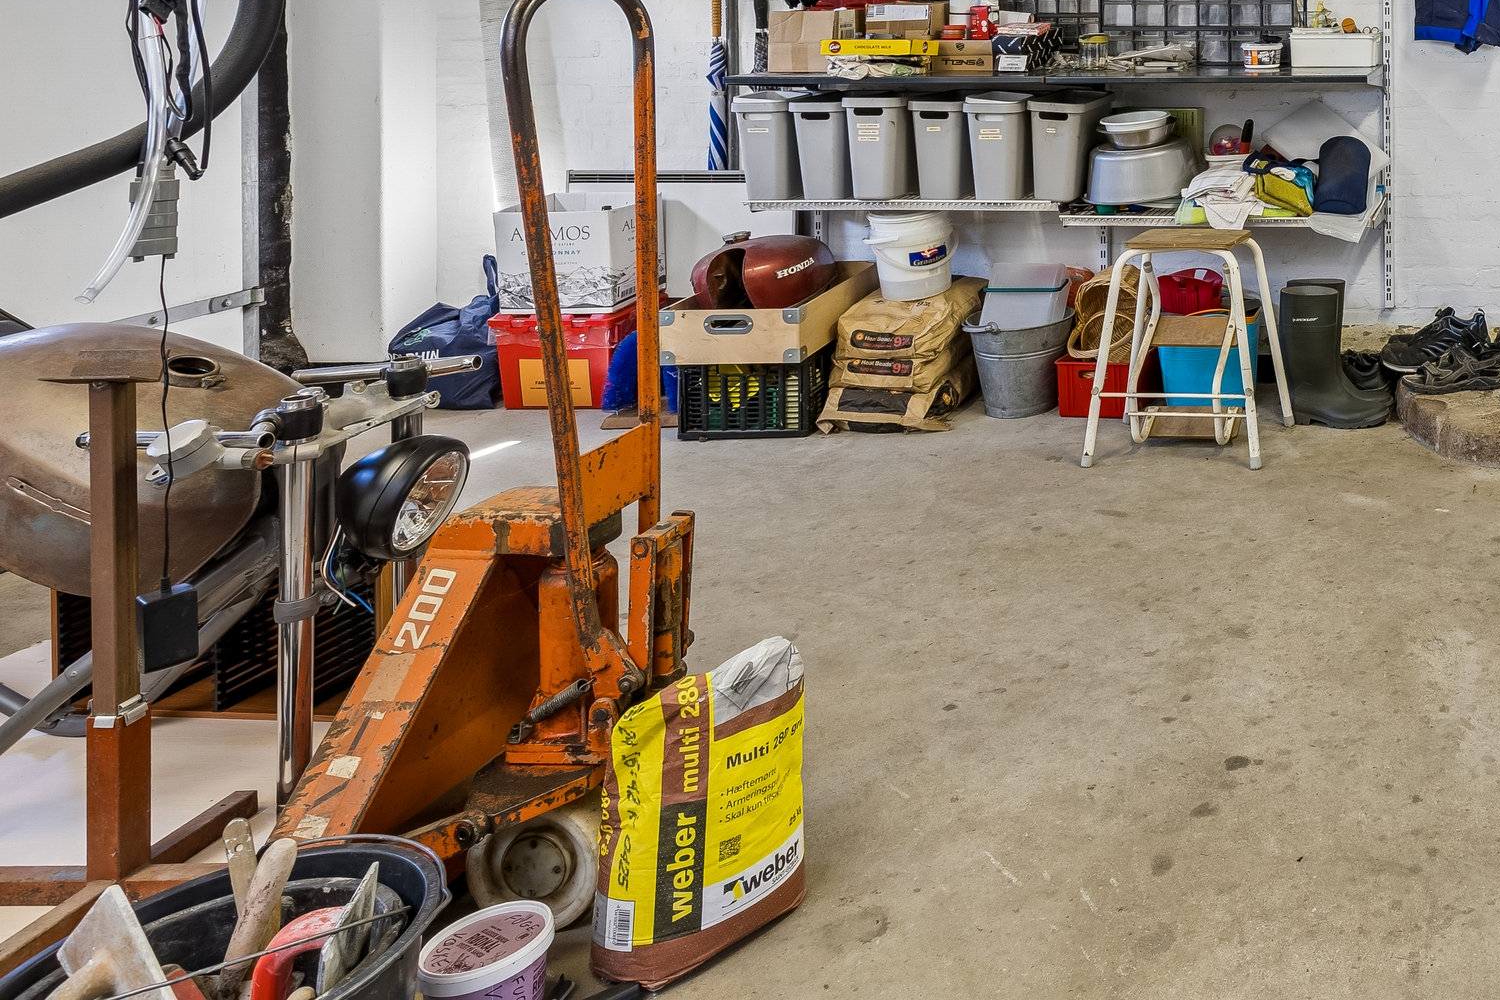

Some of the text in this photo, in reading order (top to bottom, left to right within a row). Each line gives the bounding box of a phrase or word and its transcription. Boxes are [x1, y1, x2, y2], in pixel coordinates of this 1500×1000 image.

[510, 225, 590, 242] AMOS
[520, 249, 582, 257] CONNAY
[776, 256, 815, 279] HONDA
[893, 336, 902, 347] 9
[875, 360, 893, 368] Beads
[892, 362, 901, 374] 9
[676, 674, 701, 793] multi 280
[726, 741, 769, 770] Multi
[725, 774, 781, 810] Armeringsp
[726, 767, 777, 797] Hæftemørte
[724, 807, 744, 824] Skal
[746, 799, 763, 814] kun
[665, 811, 698, 923] weber
[742, 838, 799, 895] weber
